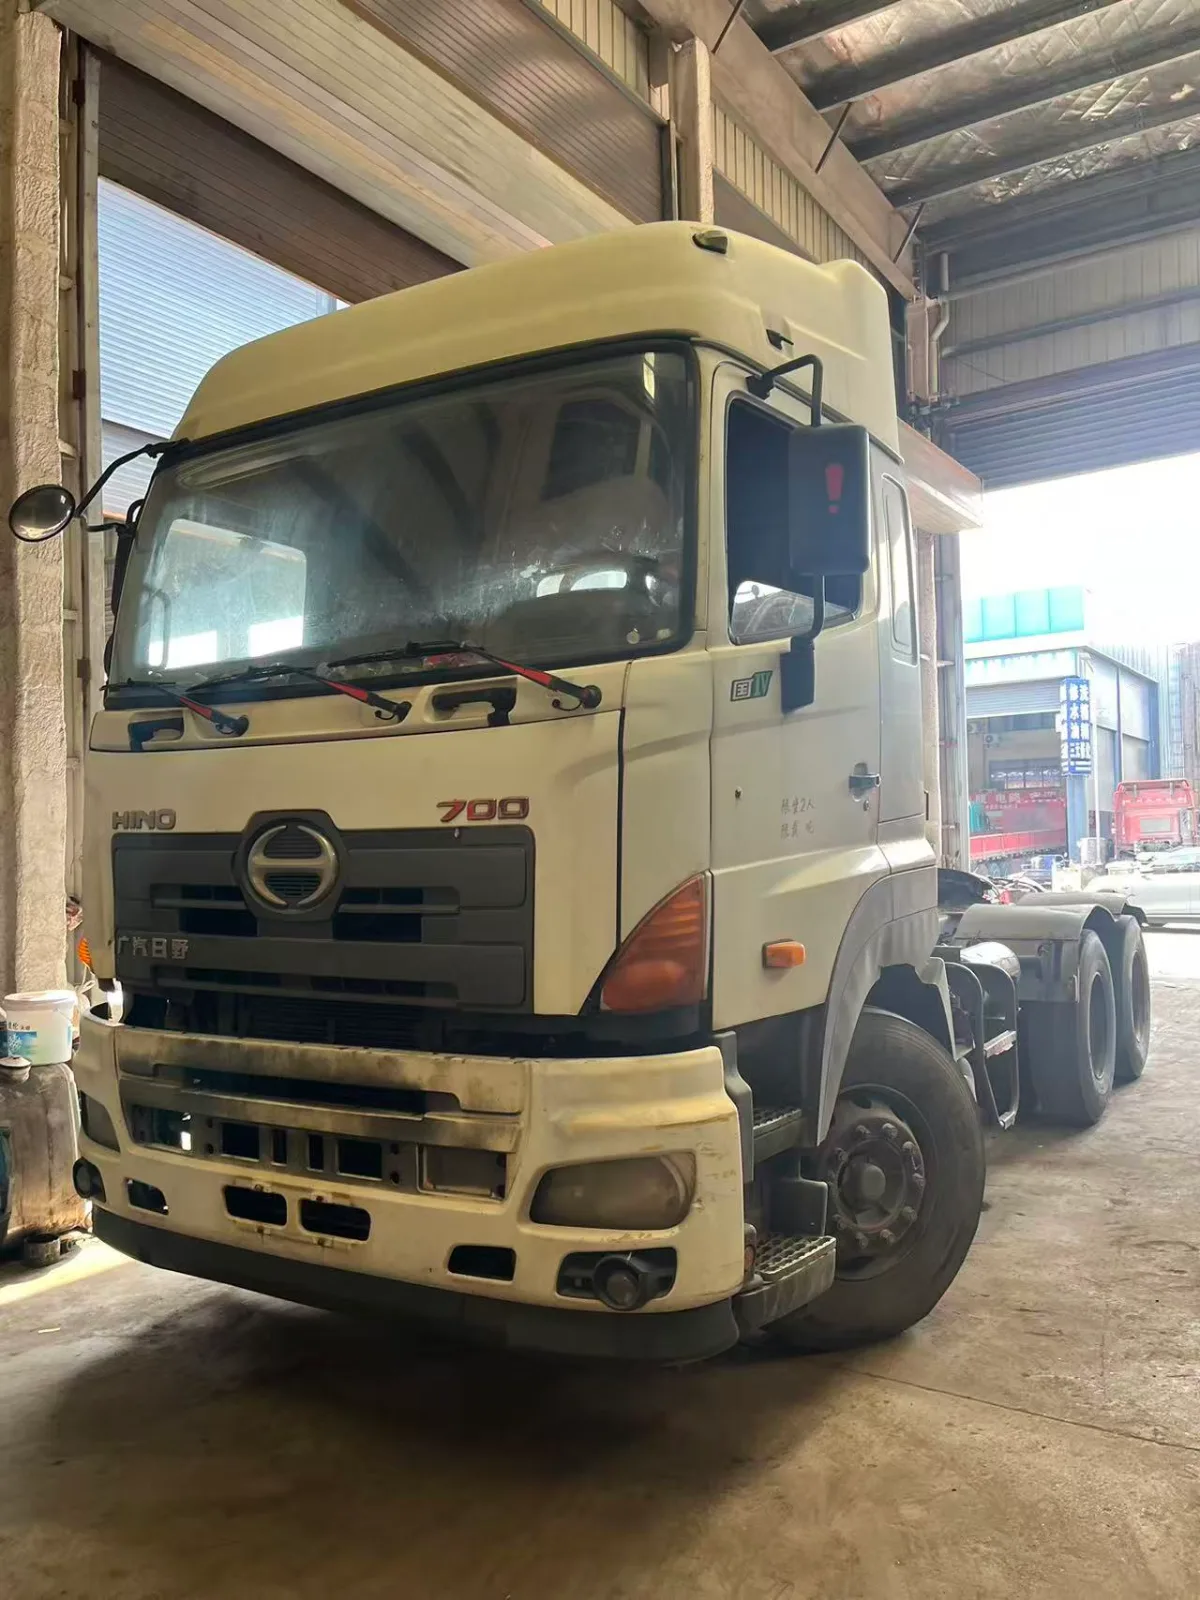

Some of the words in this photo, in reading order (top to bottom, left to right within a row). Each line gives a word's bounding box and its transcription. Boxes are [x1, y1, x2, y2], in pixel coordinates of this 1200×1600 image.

[112, 809, 176, 830] HINO
[436, 796, 529, 822] 700
[118, 935, 189, 959] 广汽日野
